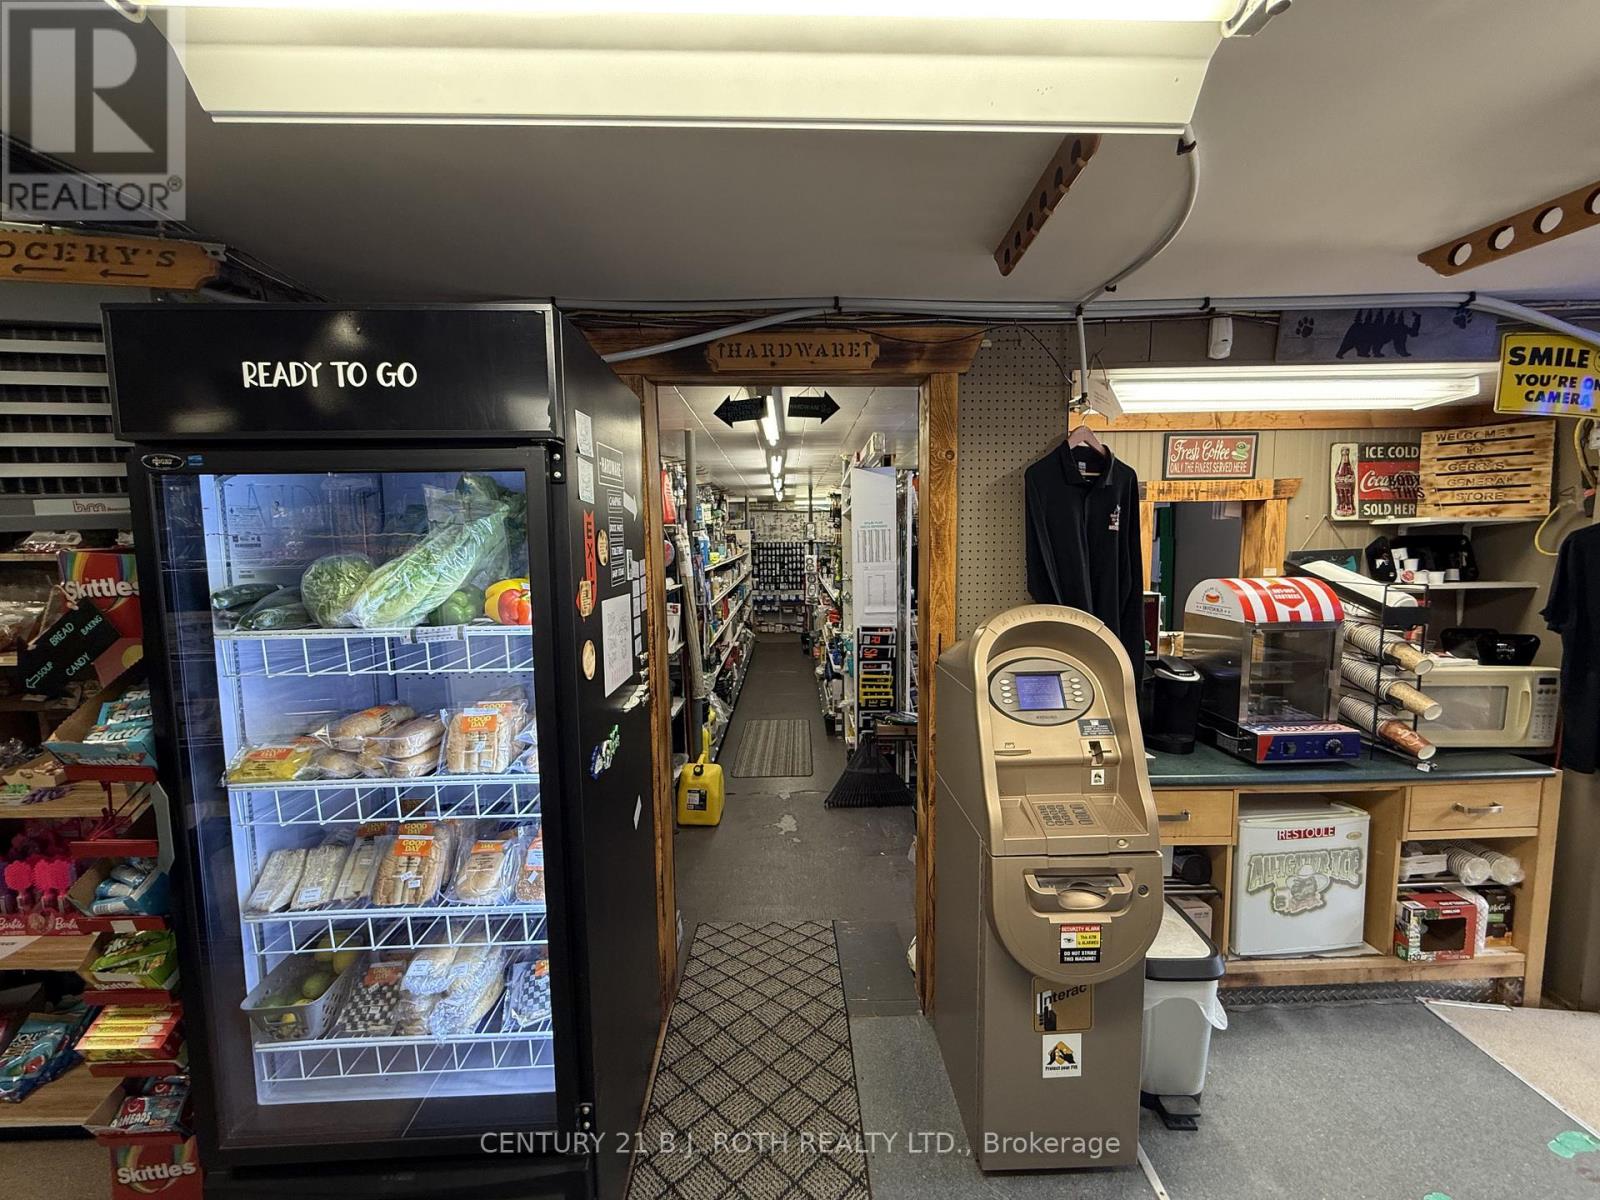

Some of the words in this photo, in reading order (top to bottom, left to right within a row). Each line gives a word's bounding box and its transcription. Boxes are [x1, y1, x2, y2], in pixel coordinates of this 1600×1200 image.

[727, 342, 860, 358] HARDWARE
[1508, 346, 1590, 368] SMILE
[241, 361, 322, 388] READY
[330, 362, 368, 387] TO
[376, 362, 418, 388] GO
[1514, 373, 1578, 388] YOU'RE
[1524, 390, 1591, 407] CAMERA
[1436, 428, 1506, 442] WELCOME
[1171, 440, 1200, 462] Fresh
[1202, 440, 1230, 460] Coffee
[1365, 446, 1383, 458] ICE
[1387, 446, 1419, 458] COLD
[1464, 445, 1484, 454] TO
[1170, 463, 1183, 473] ONLY
[1184, 462, 1194, 473] THE
[1195, 462, 1211, 473] FINEST
[1212, 461, 1232, 473] SERVED
[1233, 461, 1247, 472] HERE
[1456, 491, 1505, 501] STORE
[1363, 504, 1391, 515] SOLD
[1394, 503, 1416, 515] HER
[80, 615, 103, 636] BAKING
[49, 623, 75, 646] BREAD
[38, 661, 53, 678] SOUP
[66, 652, 90, 676] CANDY
[468, 715, 491, 723] GOOD
[1279, 827, 1335, 840] RESTOULE
[55, 917, 79, 929] Barbi
[1039, 985, 1087, 1014] Interac
[118, 1161, 197, 1184] Skittles
